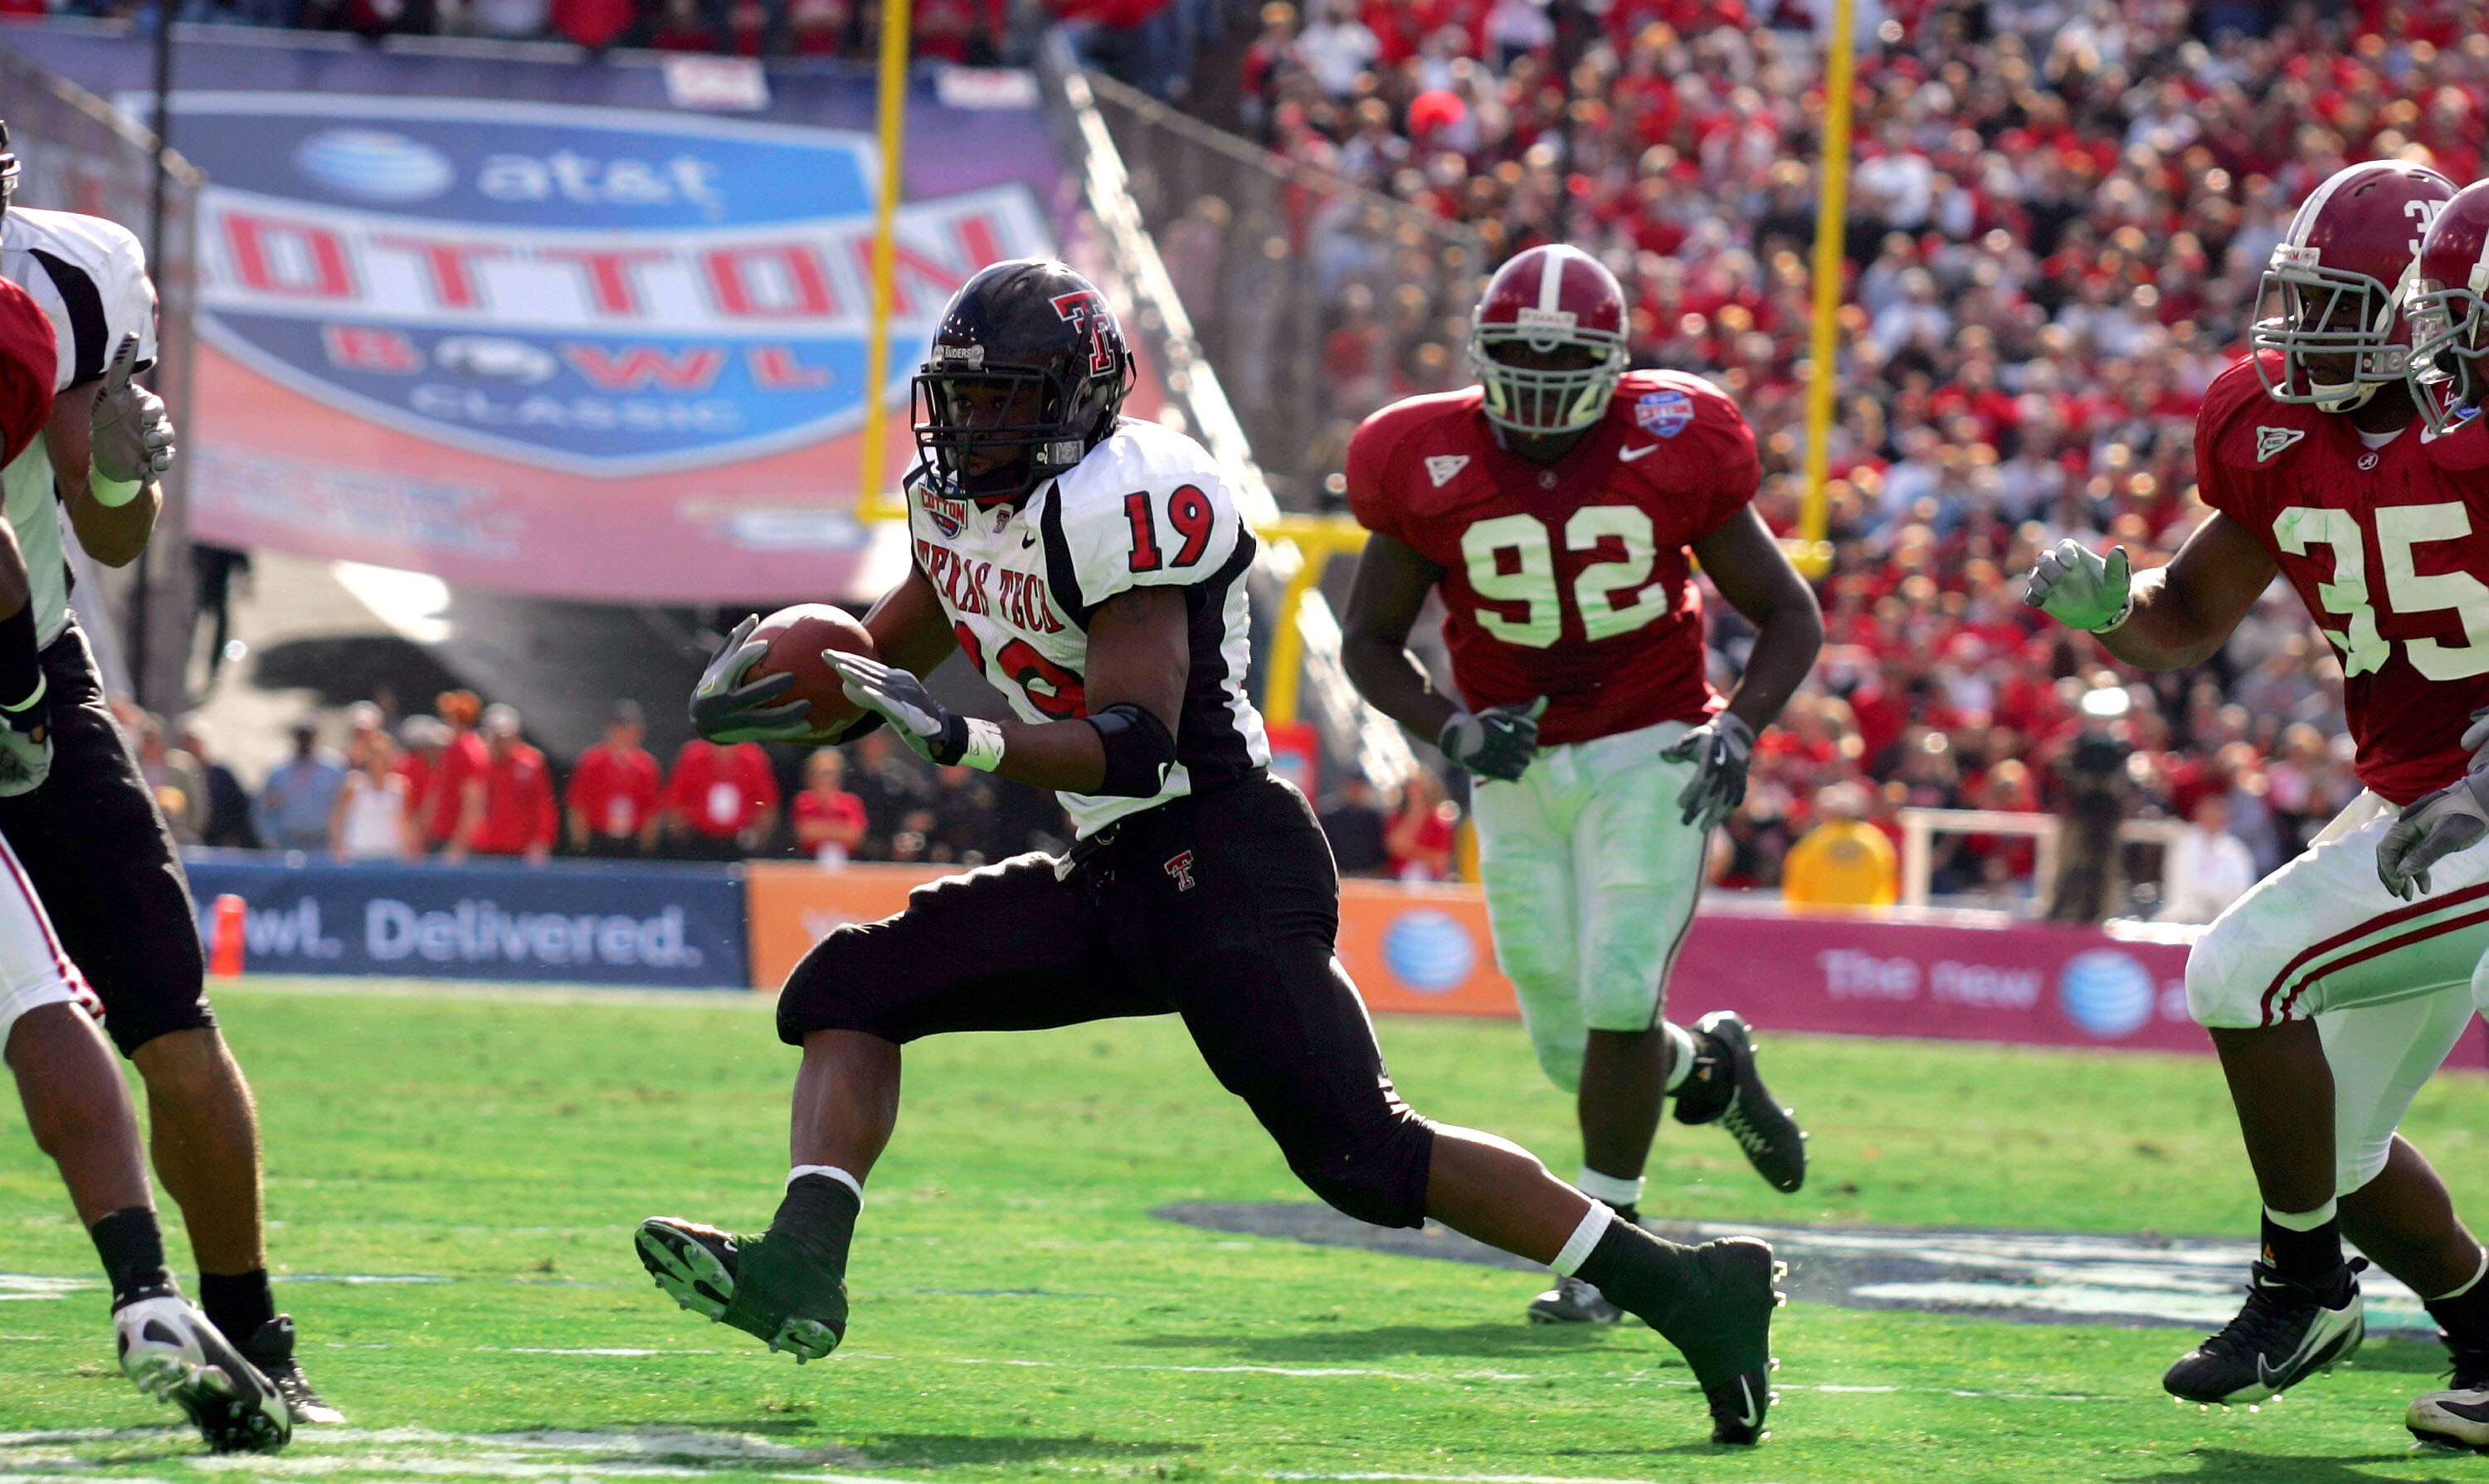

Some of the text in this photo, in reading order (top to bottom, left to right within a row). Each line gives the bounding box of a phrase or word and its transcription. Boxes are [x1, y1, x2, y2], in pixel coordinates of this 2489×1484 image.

[149, 199, 1004, 317] OTTON
[920, 488, 965, 527] COTTON
[1123, 484, 1214, 573] 19
[917, 538, 1066, 634] TEXAS TECH
[1460, 505, 1668, 650] 92
[2272, 500, 2489, 682] 35
[366, 898, 705, 968] Delivered.
[1817, 948, 2043, 1010] The new
